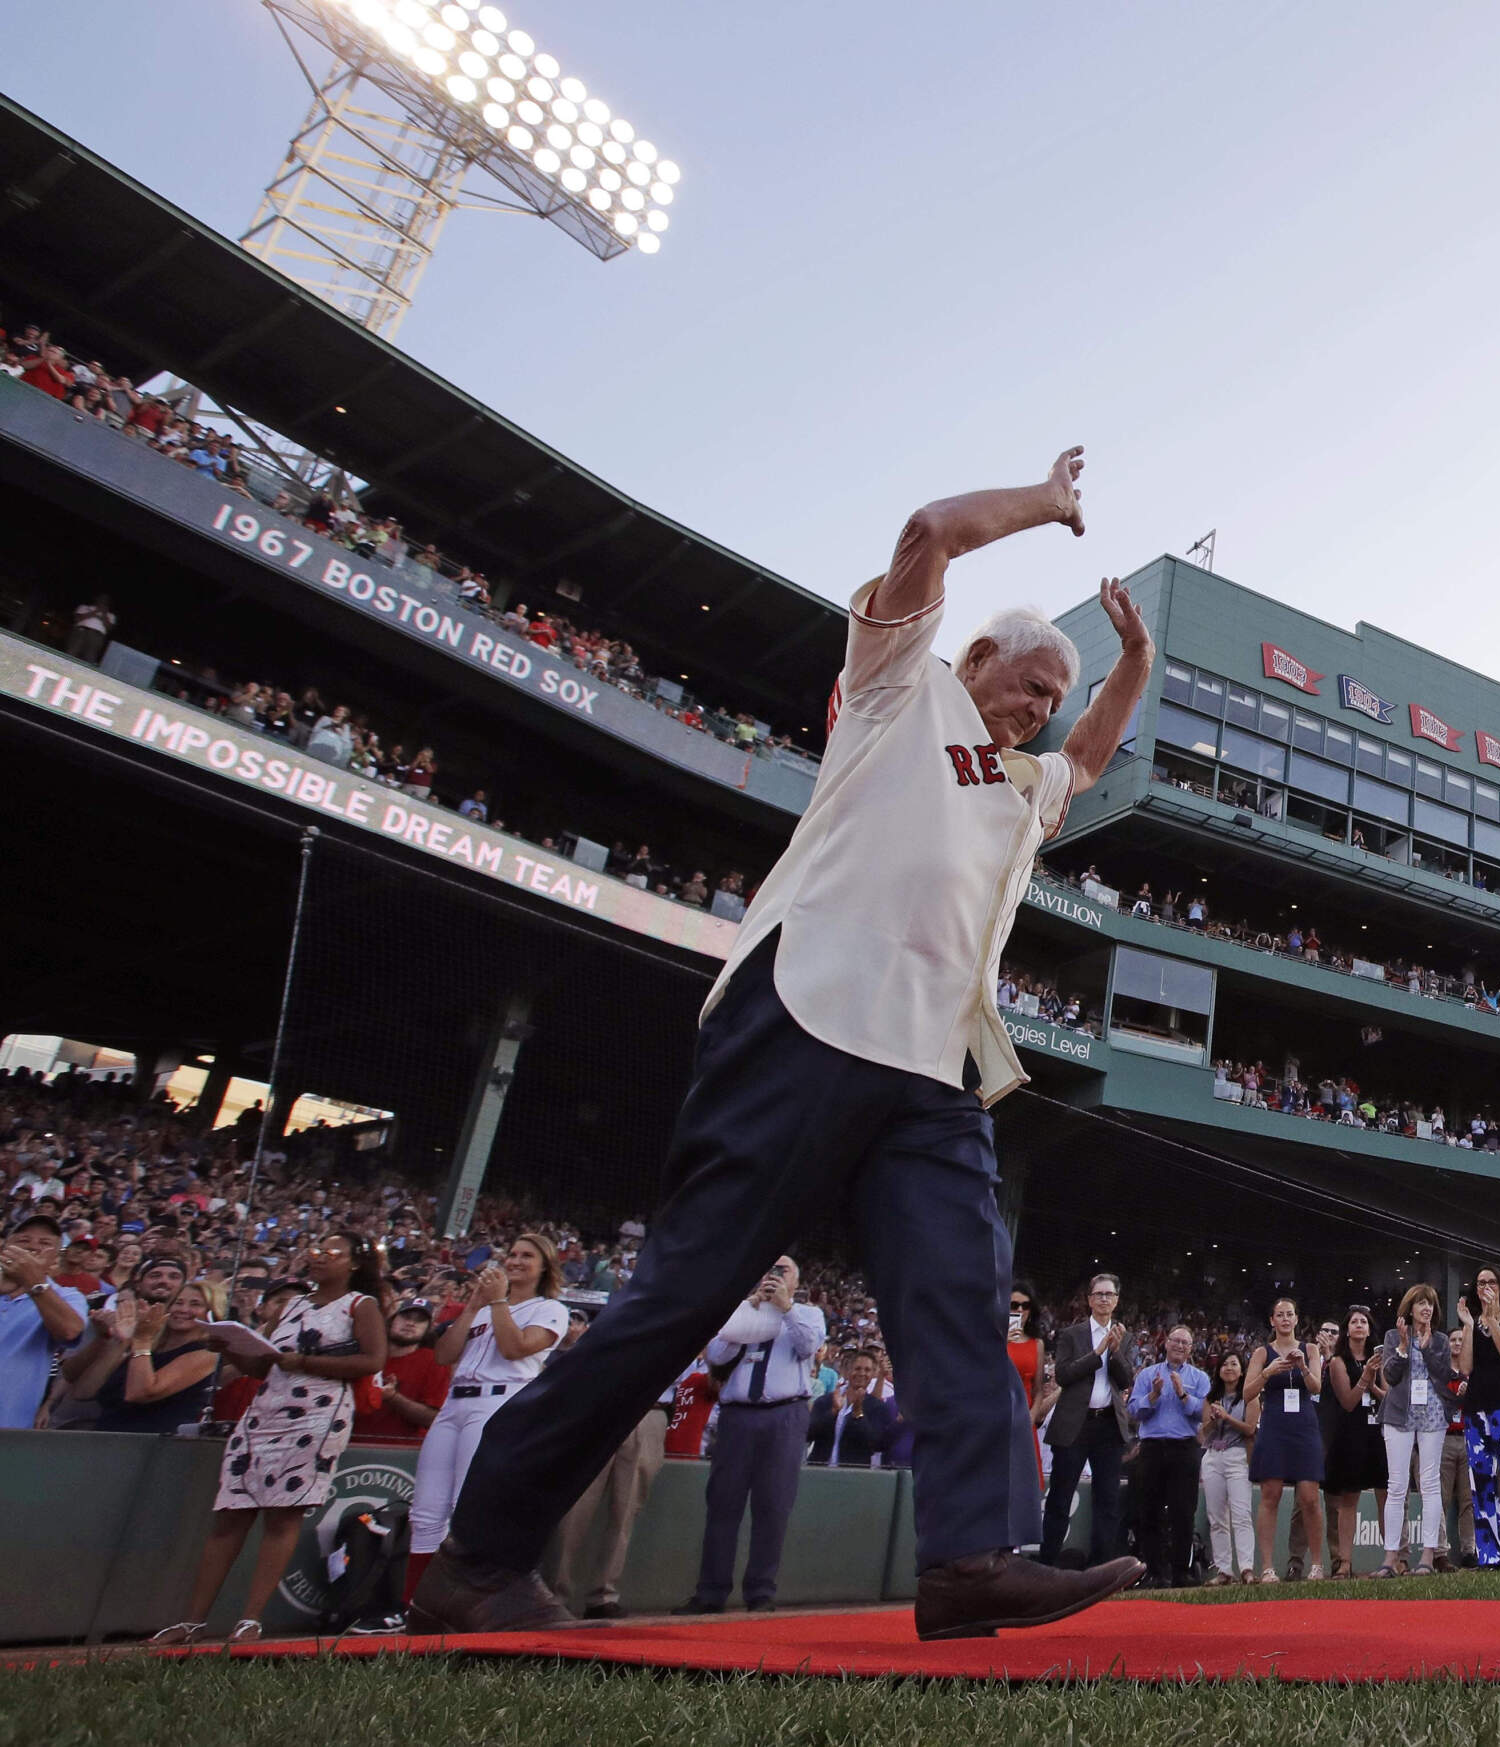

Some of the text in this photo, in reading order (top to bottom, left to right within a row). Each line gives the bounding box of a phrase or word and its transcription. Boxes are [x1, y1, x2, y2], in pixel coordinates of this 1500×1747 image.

[211, 503, 599, 716] 1967 BOSTON RED SOX
[24, 663, 599, 910] THE IMPOSSIBLE DREAM TEAM
[1026, 882, 1103, 929] PAVILION
[1051, 1031, 1090, 1060] Level
[1353, 1511, 1384, 1546] lan
